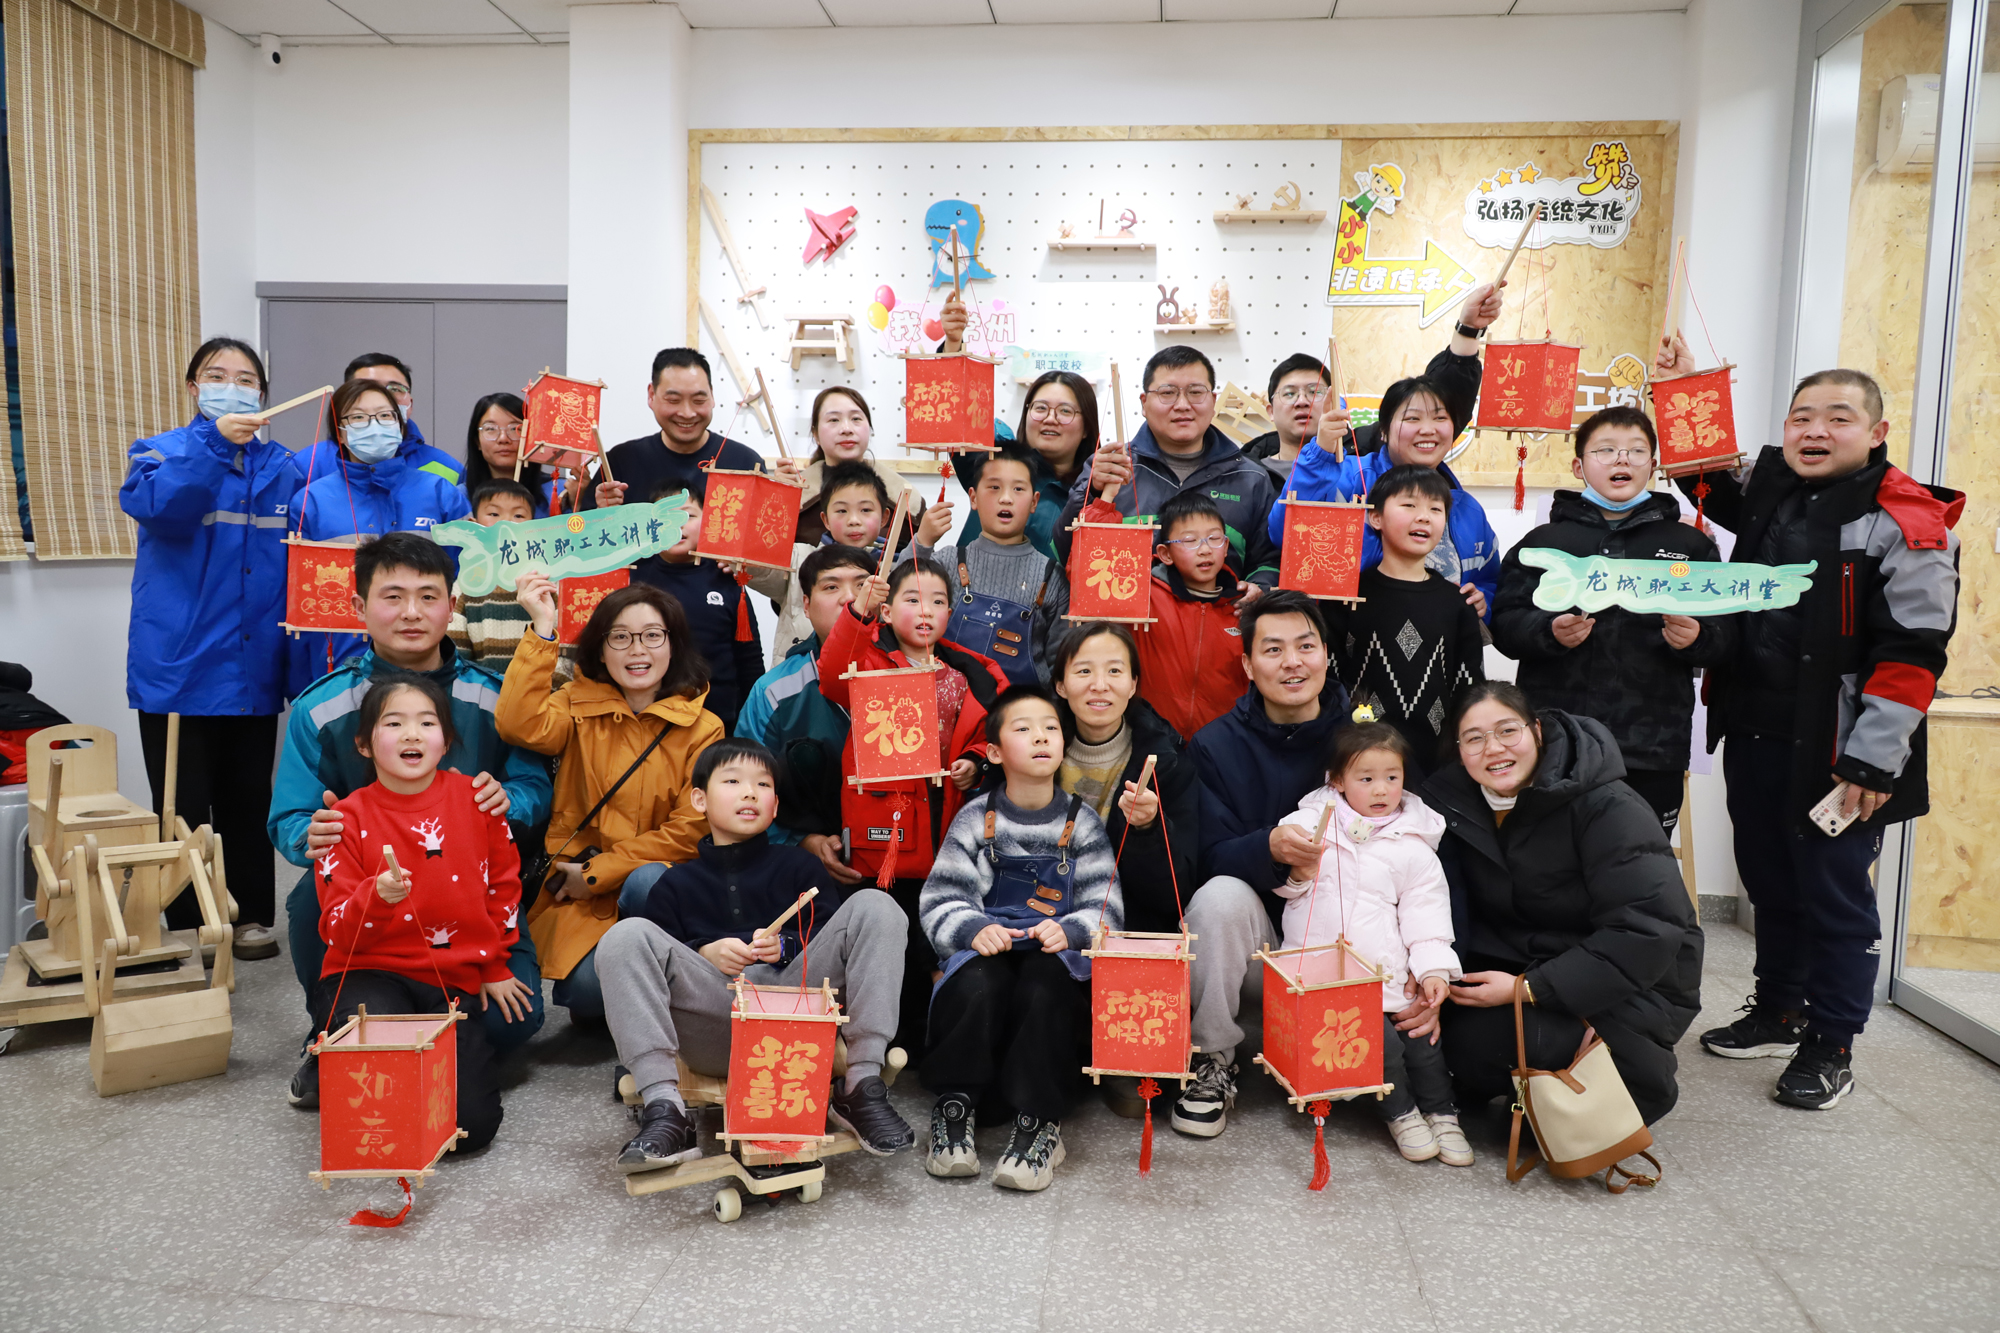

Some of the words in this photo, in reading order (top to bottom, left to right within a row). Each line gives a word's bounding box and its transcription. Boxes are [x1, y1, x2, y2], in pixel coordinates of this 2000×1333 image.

[1337, 215, 1365, 264] 小小
[1331, 266, 1473, 293] 非遗传承人
[890, 310, 921, 342] 我
[1035, 360, 1082, 370] 职工夜校
[913, 380, 953, 404] 元宵节
[1494, 352, 1526, 420] 如意
[913, 401, 952, 422] 快乐
[1665, 390, 1720, 422] 平安
[1667, 418, 1728, 453] 喜乐
[709, 484, 746, 516] 平安
[499, 518, 664, 566] 龙城职工大讲堂
[705, 508, 741, 543] 喜乐
[1586, 570, 1781, 601] 龙城职工大讲堂
[1106, 988, 1167, 1018] 元宵节
[1107, 1016, 1166, 1046] 快乐
[1311, 1006, 1370, 1073] 福
[747, 1035, 820, 1081] 平安
[427, 1054, 450, 1132] 福
[742, 1069, 817, 1119] 喜乐
[347, 1062, 396, 1160] 如意
